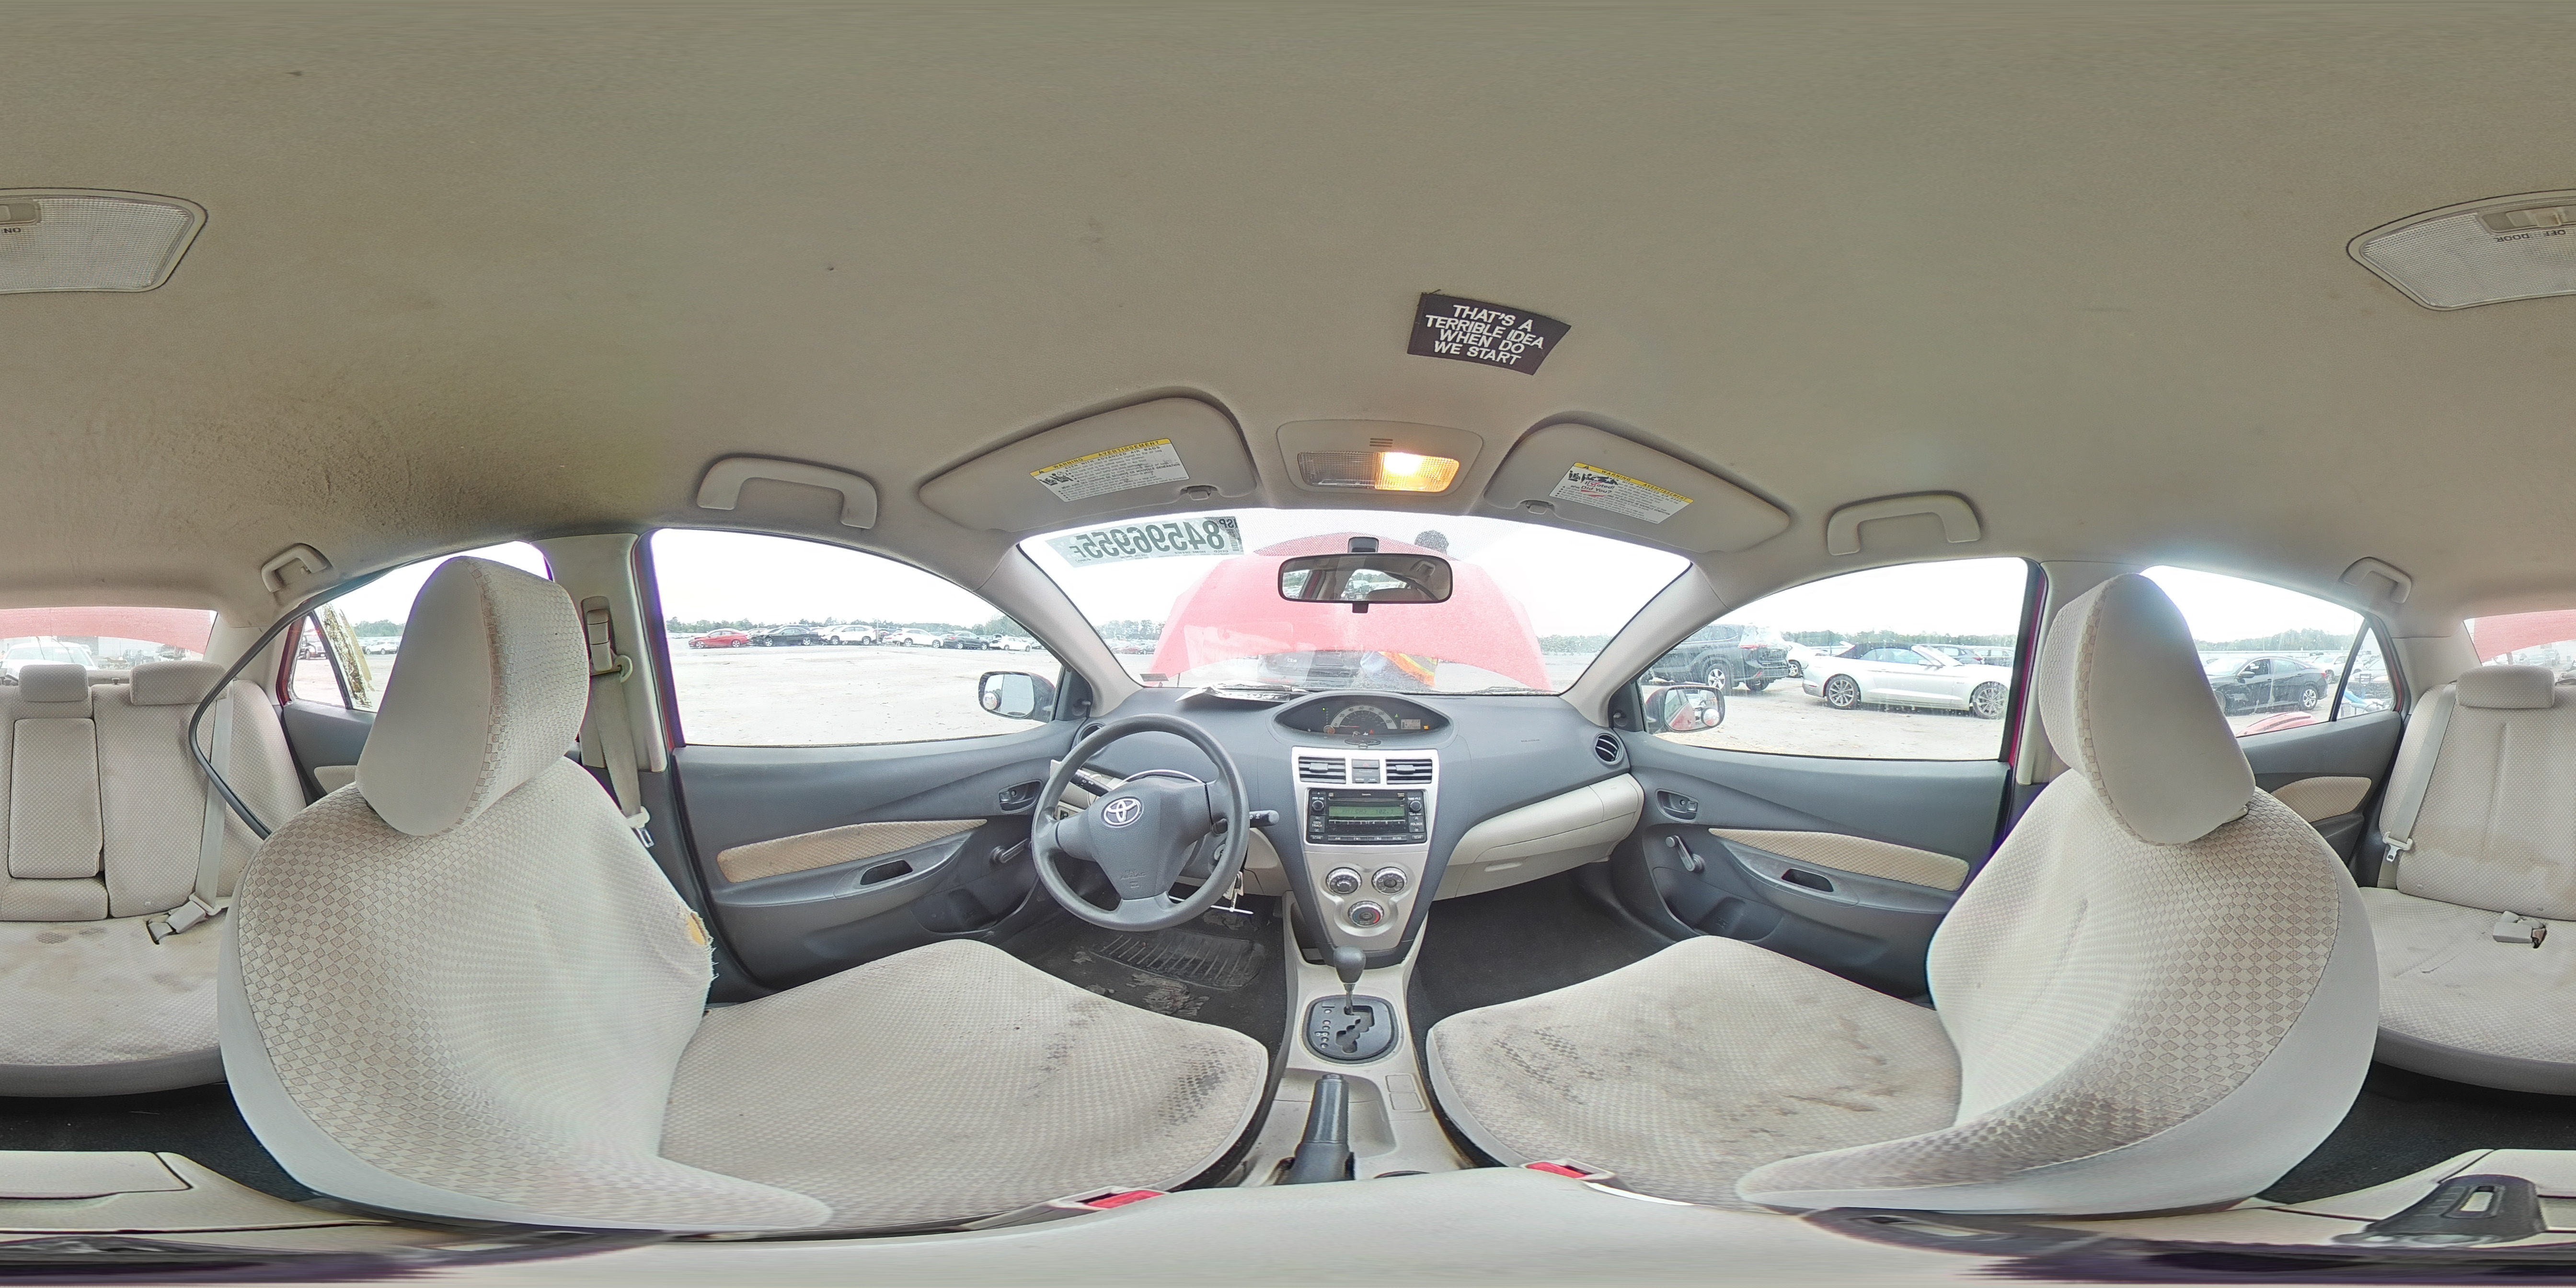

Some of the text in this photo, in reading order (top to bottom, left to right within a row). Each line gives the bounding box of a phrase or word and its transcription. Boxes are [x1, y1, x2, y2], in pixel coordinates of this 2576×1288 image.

[2494, 233, 2531, 242] DOOR
[1453, 305, 1533, 332] THAT'S A
[1425, 315, 1544, 349] TERRIBLE IDEA
[1439, 329, 1525, 354] WHEN DO
[1434, 341, 1521, 365] WE START
[1053, 458, 1083, 469] WARNING
[1098, 440, 1160, 457] AVERTISSEMENT
[1097, 453, 1127, 461] ADVANCED
[1601, 470, 1688, 501] WARNING AVERTISSEMENT
